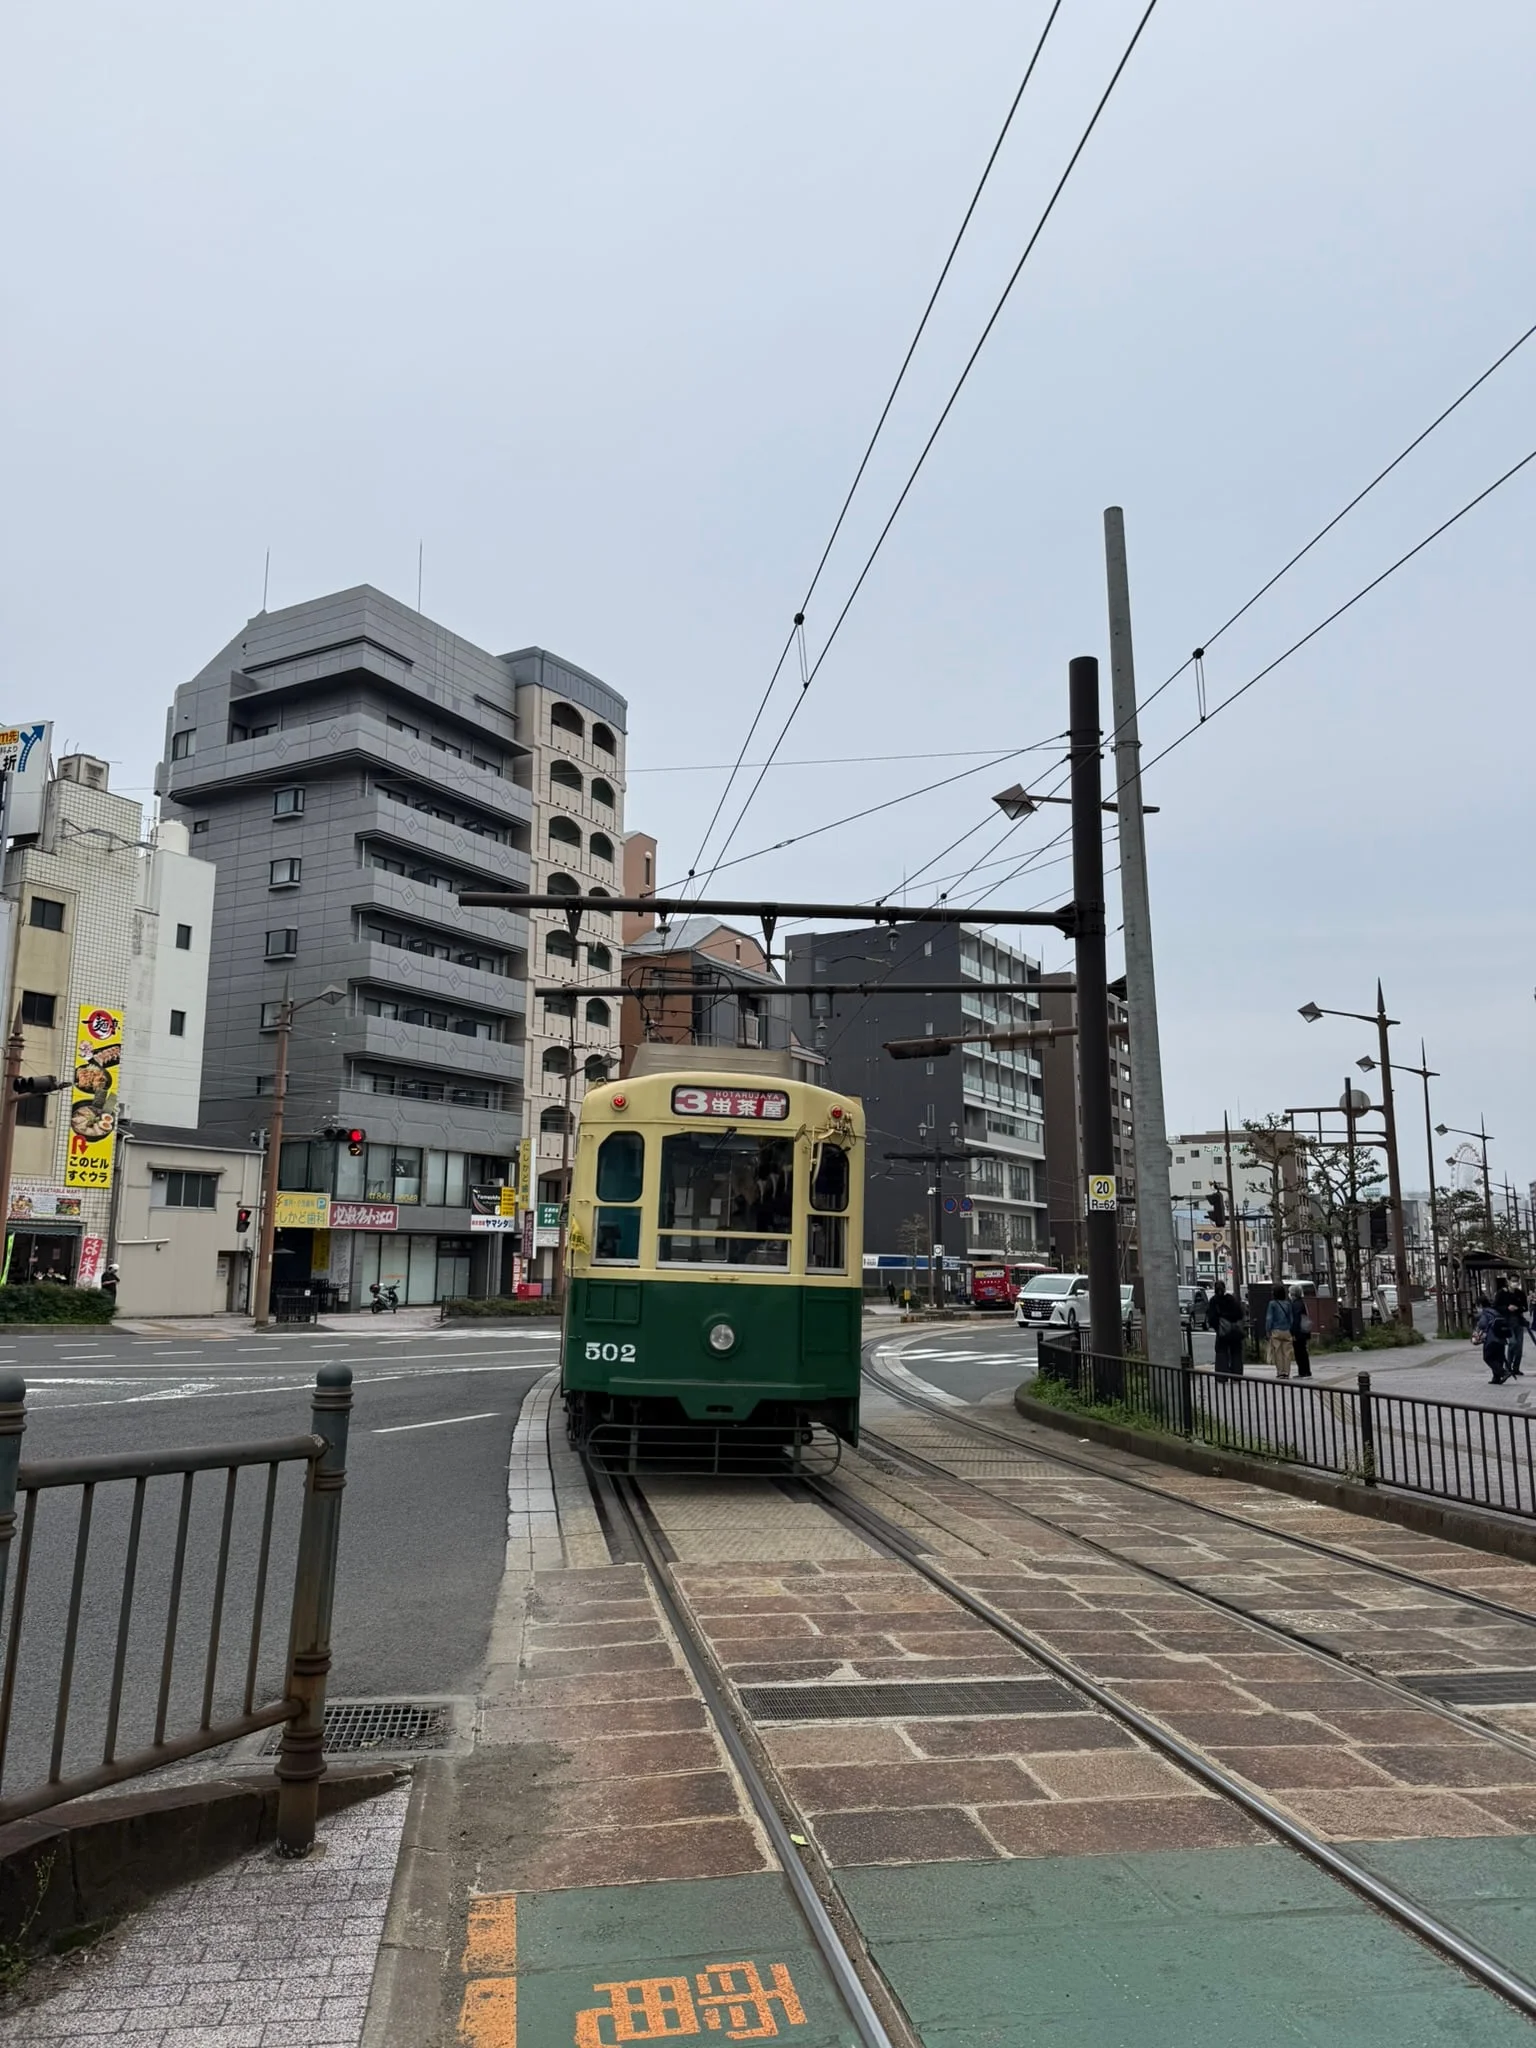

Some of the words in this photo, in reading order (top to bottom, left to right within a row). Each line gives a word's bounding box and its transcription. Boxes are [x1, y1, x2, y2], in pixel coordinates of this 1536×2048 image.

[676, 1089, 708, 1114] 3
[69, 1156, 109, 1169] このビル
[68, 1169, 108, 1183] すぐウラ
[1096, 1181, 1109, 1194] 20
[1091, 1199, 1115, 1210] R=62
[486, 1219, 509, 1228] ヤマシタ
[585, 1342, 636, 1363] 502
